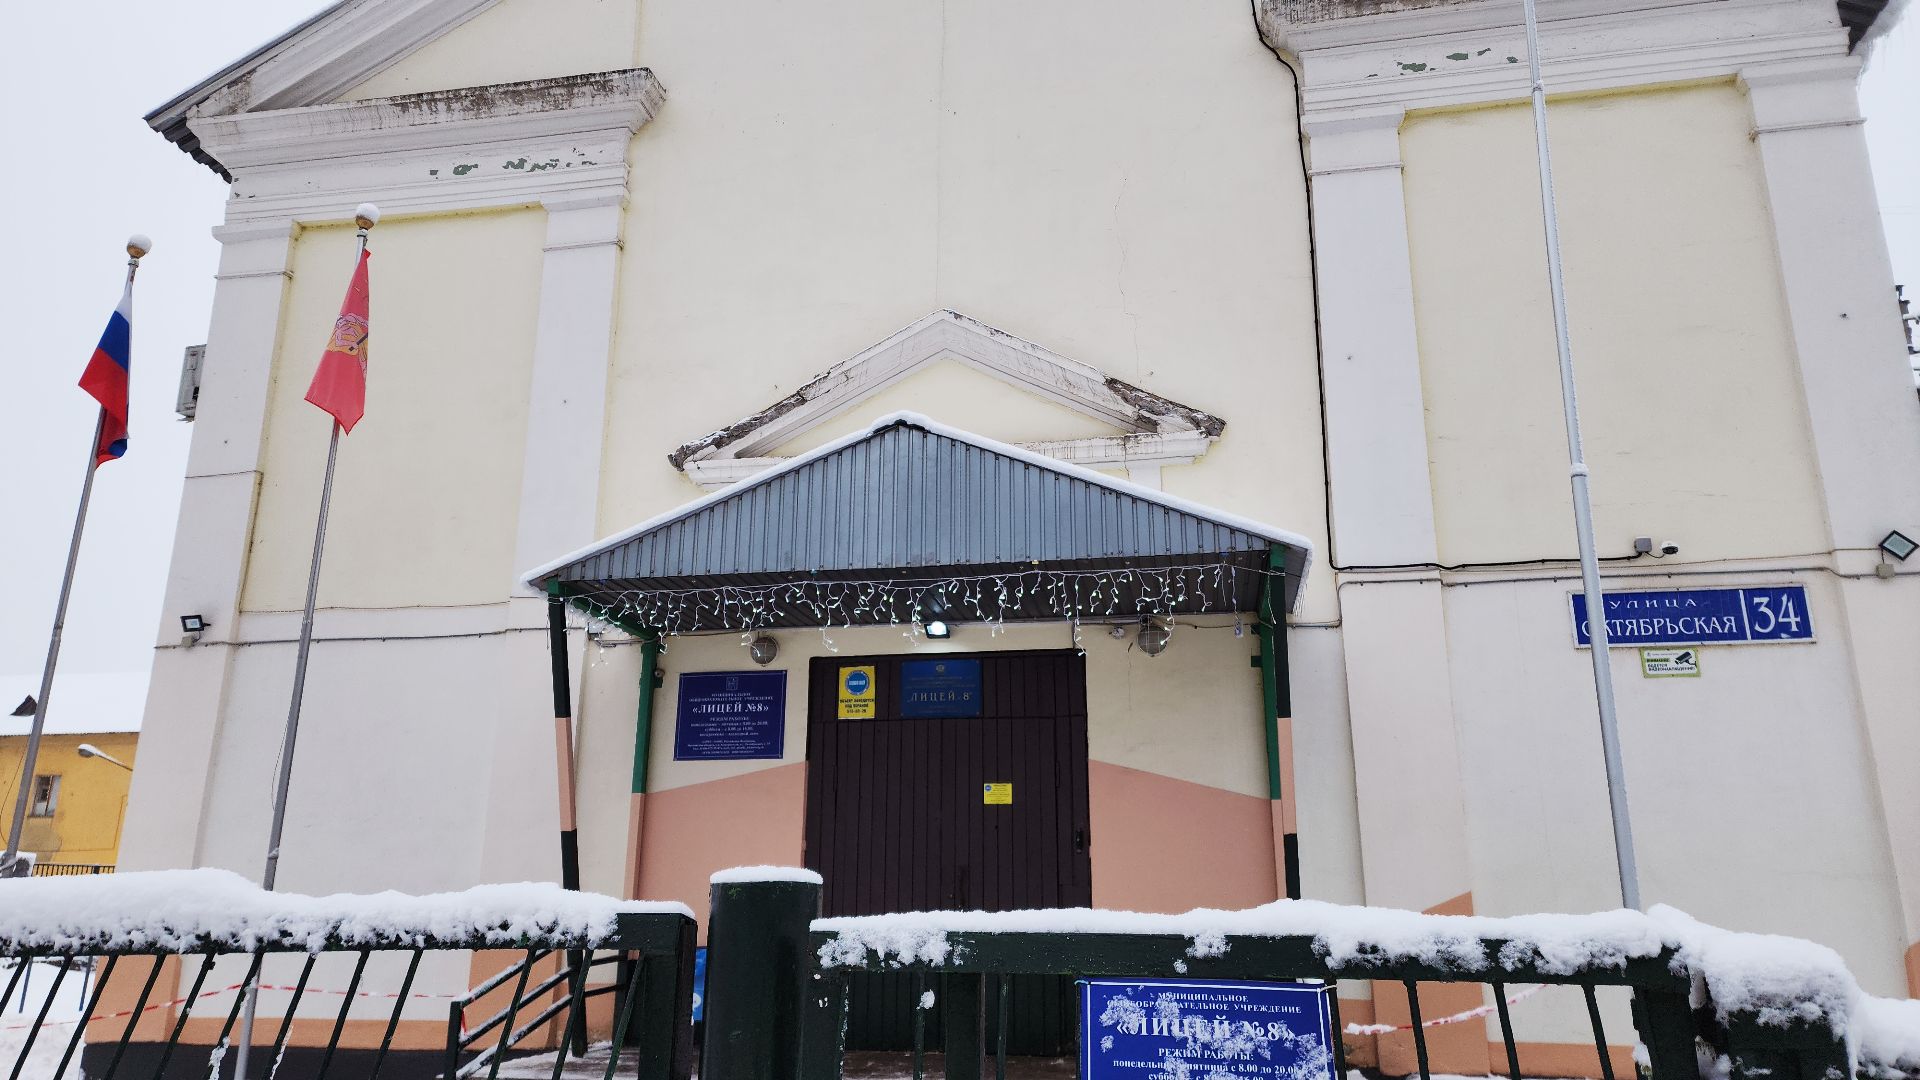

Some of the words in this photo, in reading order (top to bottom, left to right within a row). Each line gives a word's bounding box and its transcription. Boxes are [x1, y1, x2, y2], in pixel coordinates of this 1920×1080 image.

[1609, 598, 1698, 609] УЛИЦА
[1753, 593, 1801, 633] 34
[692, 701, 742, 714] «ЛИЦЕЙ
[745, 702, 769, 713] №8»
[1233, 1003, 1302, 1014] УЧРЕЖДЕНИЕ
[1158, 1047, 1201, 1058] РЕЖИМ
[1113, 1059, 1173, 1069] понедельн
[1187, 1062, 1228, 1072] пятница
[1238, 1064, 1258, 1073] 8.00
[1260, 1066, 1272, 1074] до
[1274, 1065, 1300, 1074] 20.0
